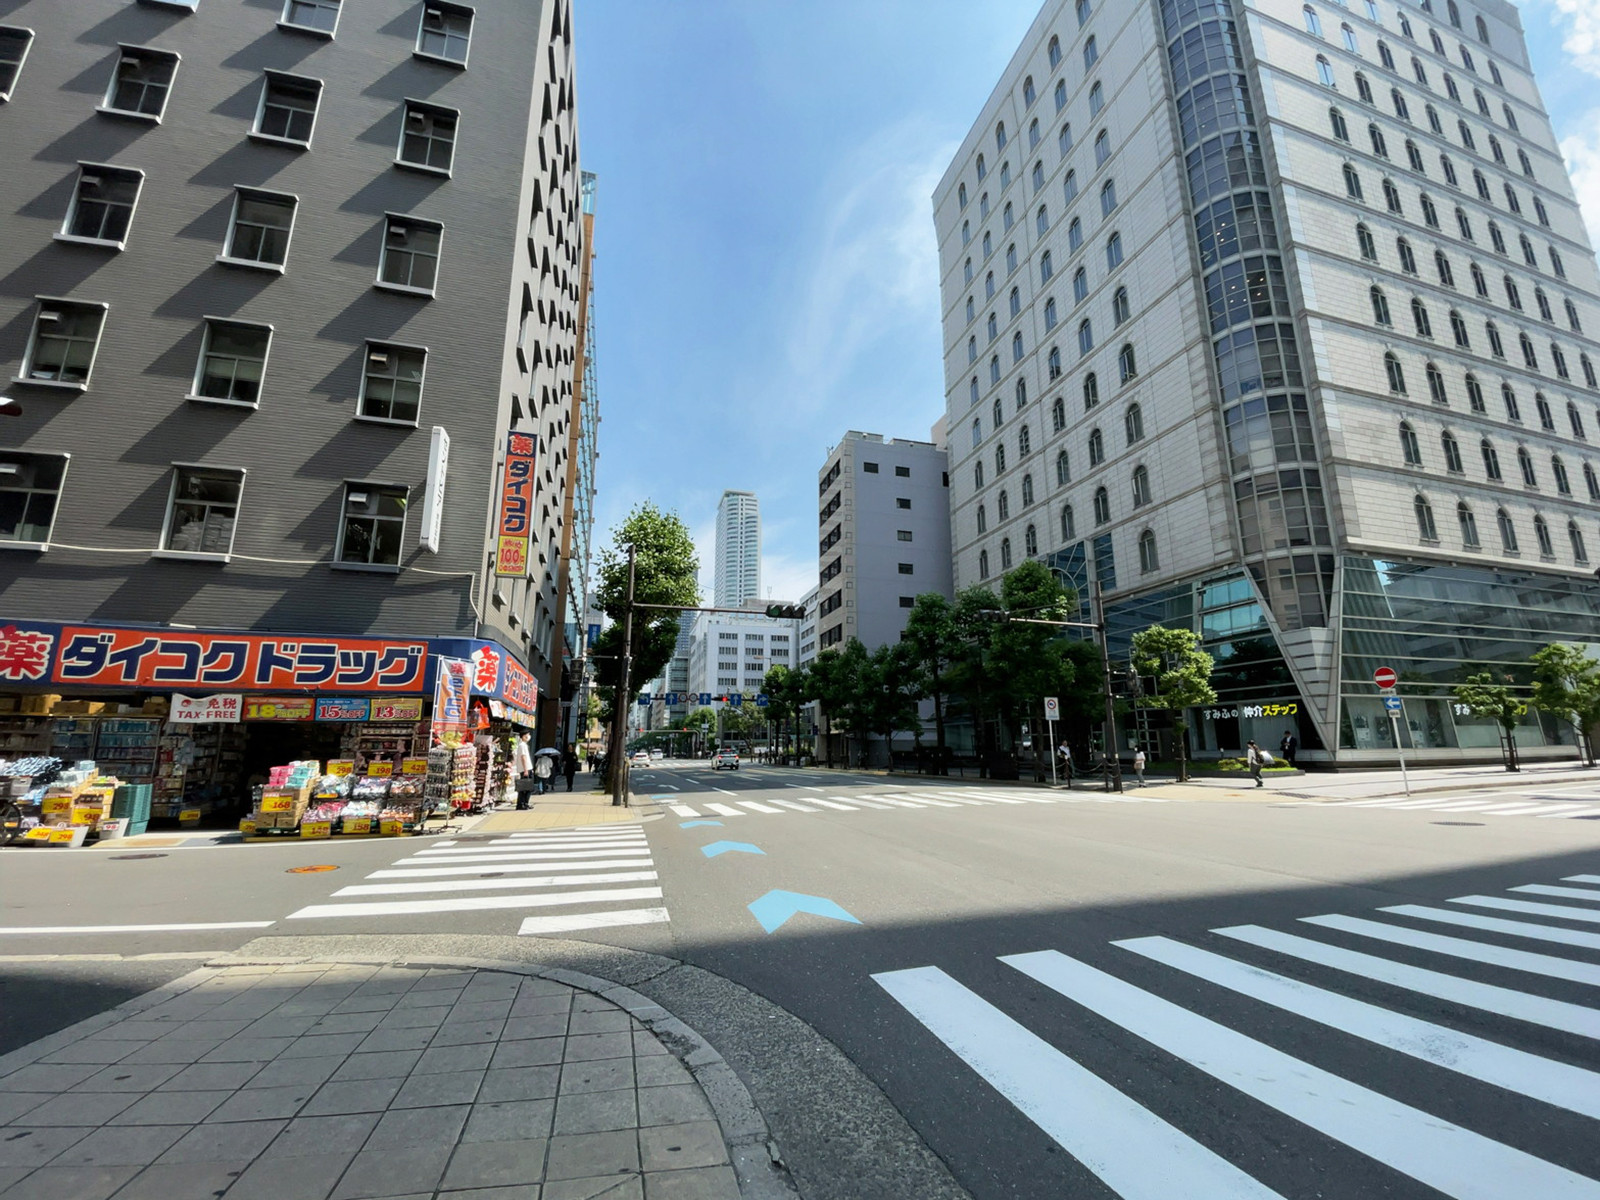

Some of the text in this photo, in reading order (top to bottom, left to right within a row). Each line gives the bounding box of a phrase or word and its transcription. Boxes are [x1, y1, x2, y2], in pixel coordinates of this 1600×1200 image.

[509, 433, 534, 455] 薬
[504, 460, 531, 533] ダイコク
[60, 632, 423, 687] ダイコクドラッグ
[472, 645, 500, 693] 薬
[177, 710, 236, 719] TAX-FREE
[206, 698, 237, 710] 免税
[376, 767, 391, 775] 198
